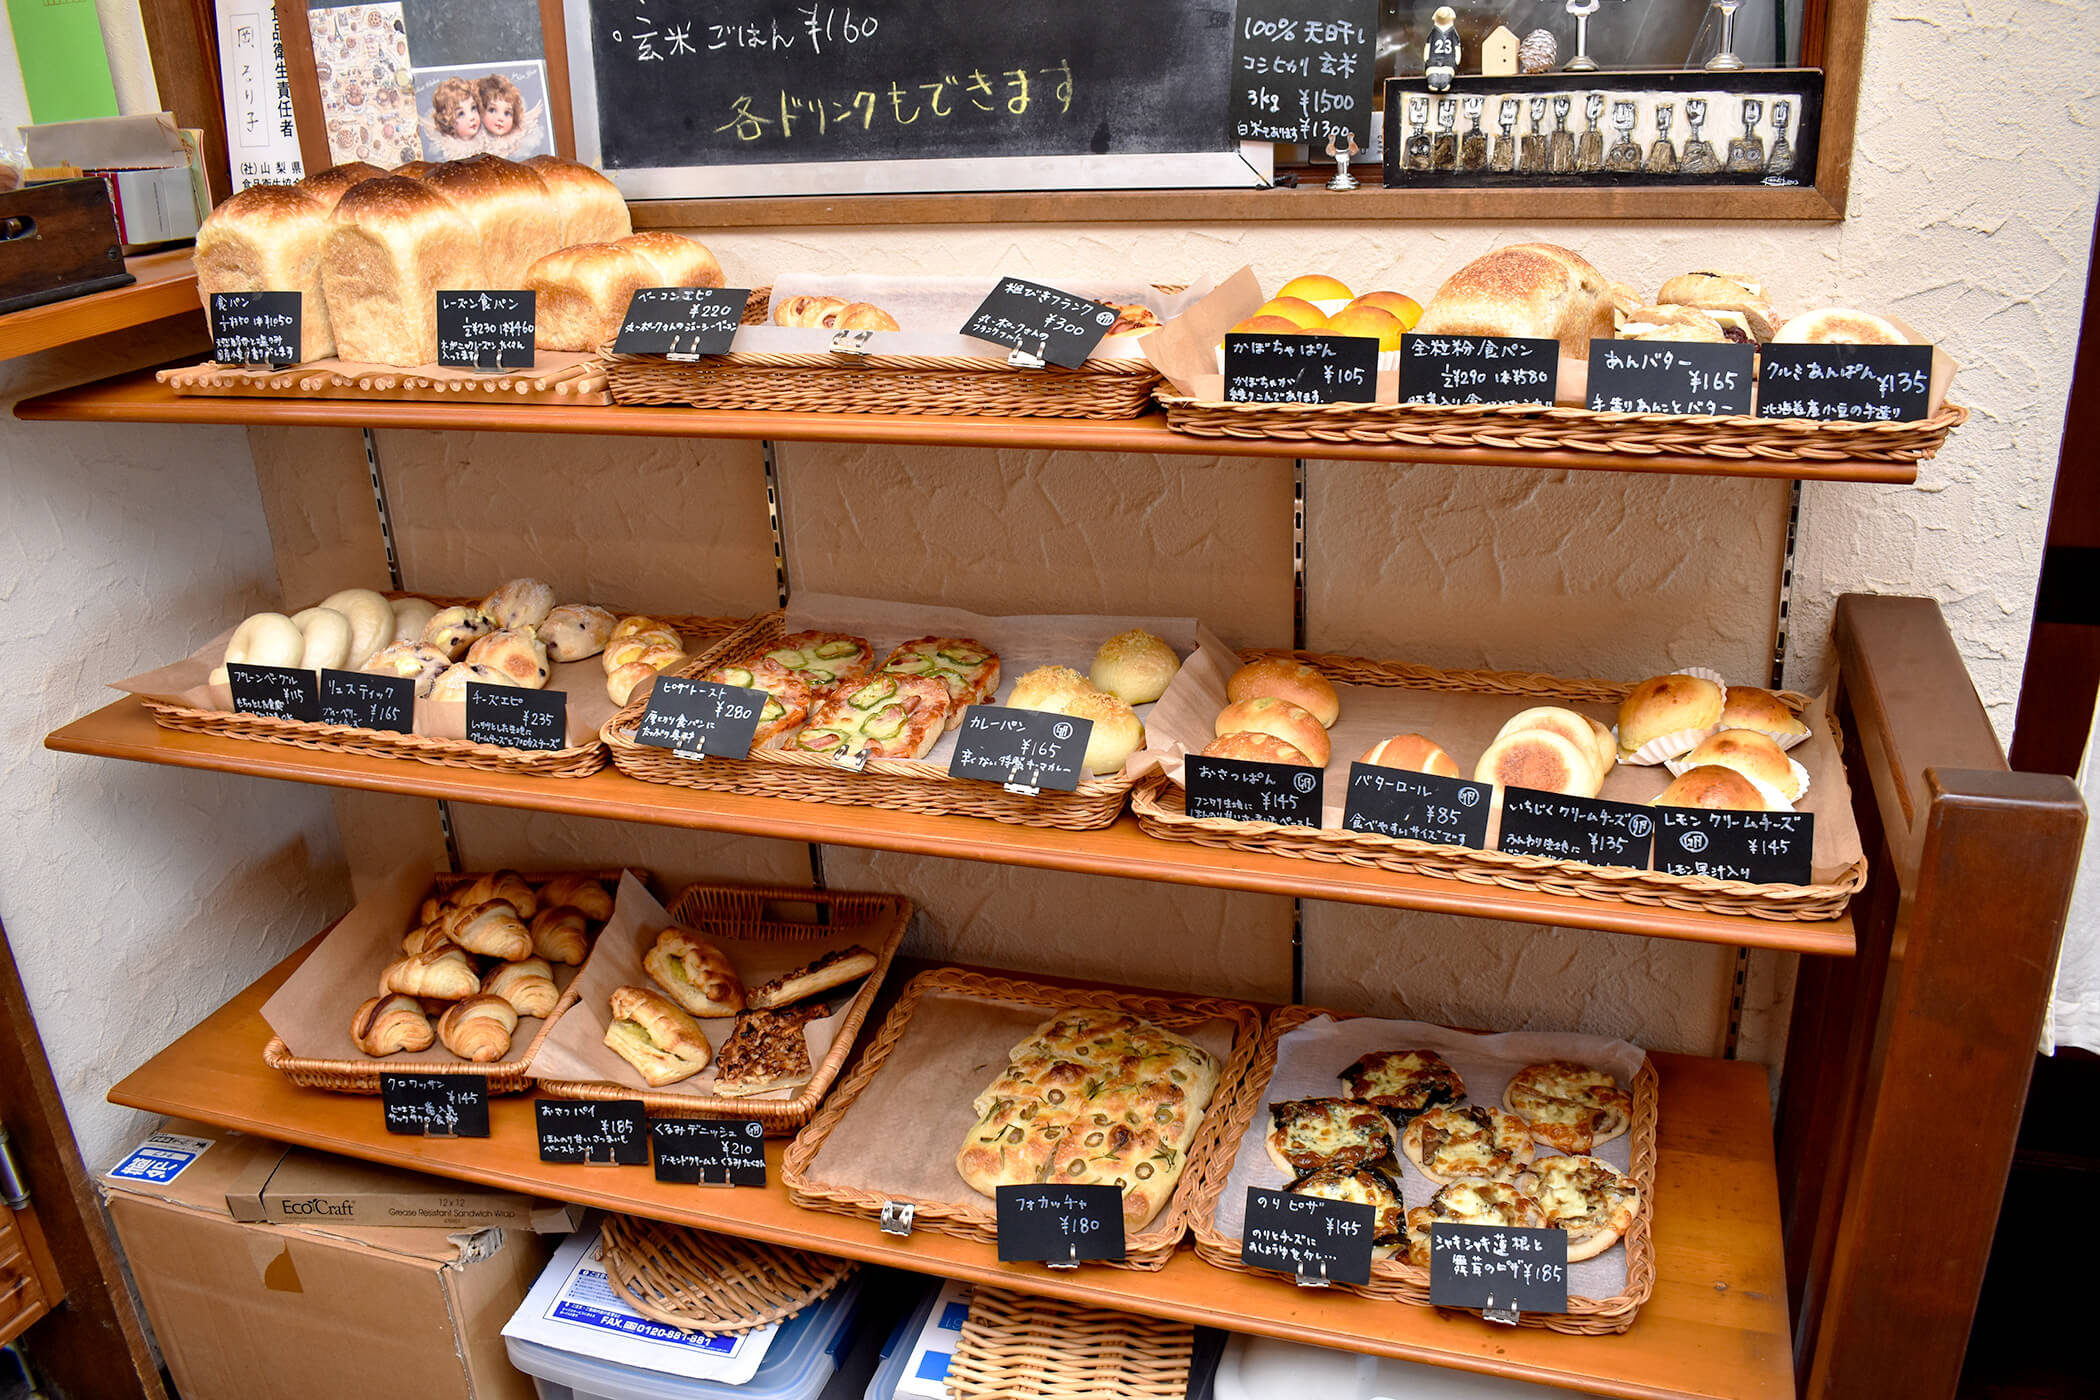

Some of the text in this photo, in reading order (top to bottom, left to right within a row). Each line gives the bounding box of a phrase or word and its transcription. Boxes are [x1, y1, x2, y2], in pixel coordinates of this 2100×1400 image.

[1244, 17, 1365, 45] 100% 天日干し
[1434, 39, 1452, 54] 23
[1247, 86, 1280, 112] 3kg
[216, 294, 249, 311] 食パン
[442, 292, 519, 311] レーズン食パン
[638, 290, 712, 302] ベーコンエピ
[689, 303, 731, 318] ¥220
[1044, 313, 1085, 336] ¥300
[1233, 339, 1337, 357] かぼちゃぱん
[1604, 350, 1692, 370] あんバター
[1323, 364, 1365, 385] ¥105
[1689, 370, 1738, 393] ¥165
[1876, 370, 1927, 398] ¥135
[283, 688, 304, 704] ¥115
[472, 690, 524, 706] チーズエピ
[664, 682, 727, 699] ピザトースト
[370, 704, 400, 722] ¥165
[523, 709, 554, 727] ¥235
[715, 701, 752, 719] ¥280
[970, 716, 1026, 732] カレーパン
[1021, 738, 1061, 758] ¥165
[1355, 775, 1432, 797] バターロール
[1261, 791, 1299, 811] ¥145
[1426, 804, 1461, 825] ¥85
[1588, 832, 1629, 854] ¥135
[1748, 838, 1790, 855] ¥145
[387, 1078, 445, 1091] クロワッサン
[446, 1090, 478, 1105] ¥145
[600, 1119, 633, 1135] ¥185
[655, 1123, 737, 1139] くるみデニッシュ
[721, 1140, 752, 1157] ¥210
[1015, 1194, 1087, 1211] フォカッチャ
[388, 1207, 417, 1217] Grease
[418, 1208, 452, 1217] Resistant
[1059, 1216, 1100, 1235] ¥180
[1325, 1217, 1362, 1236] ¥145
[1524, 1263, 1563, 1286] ¥185
